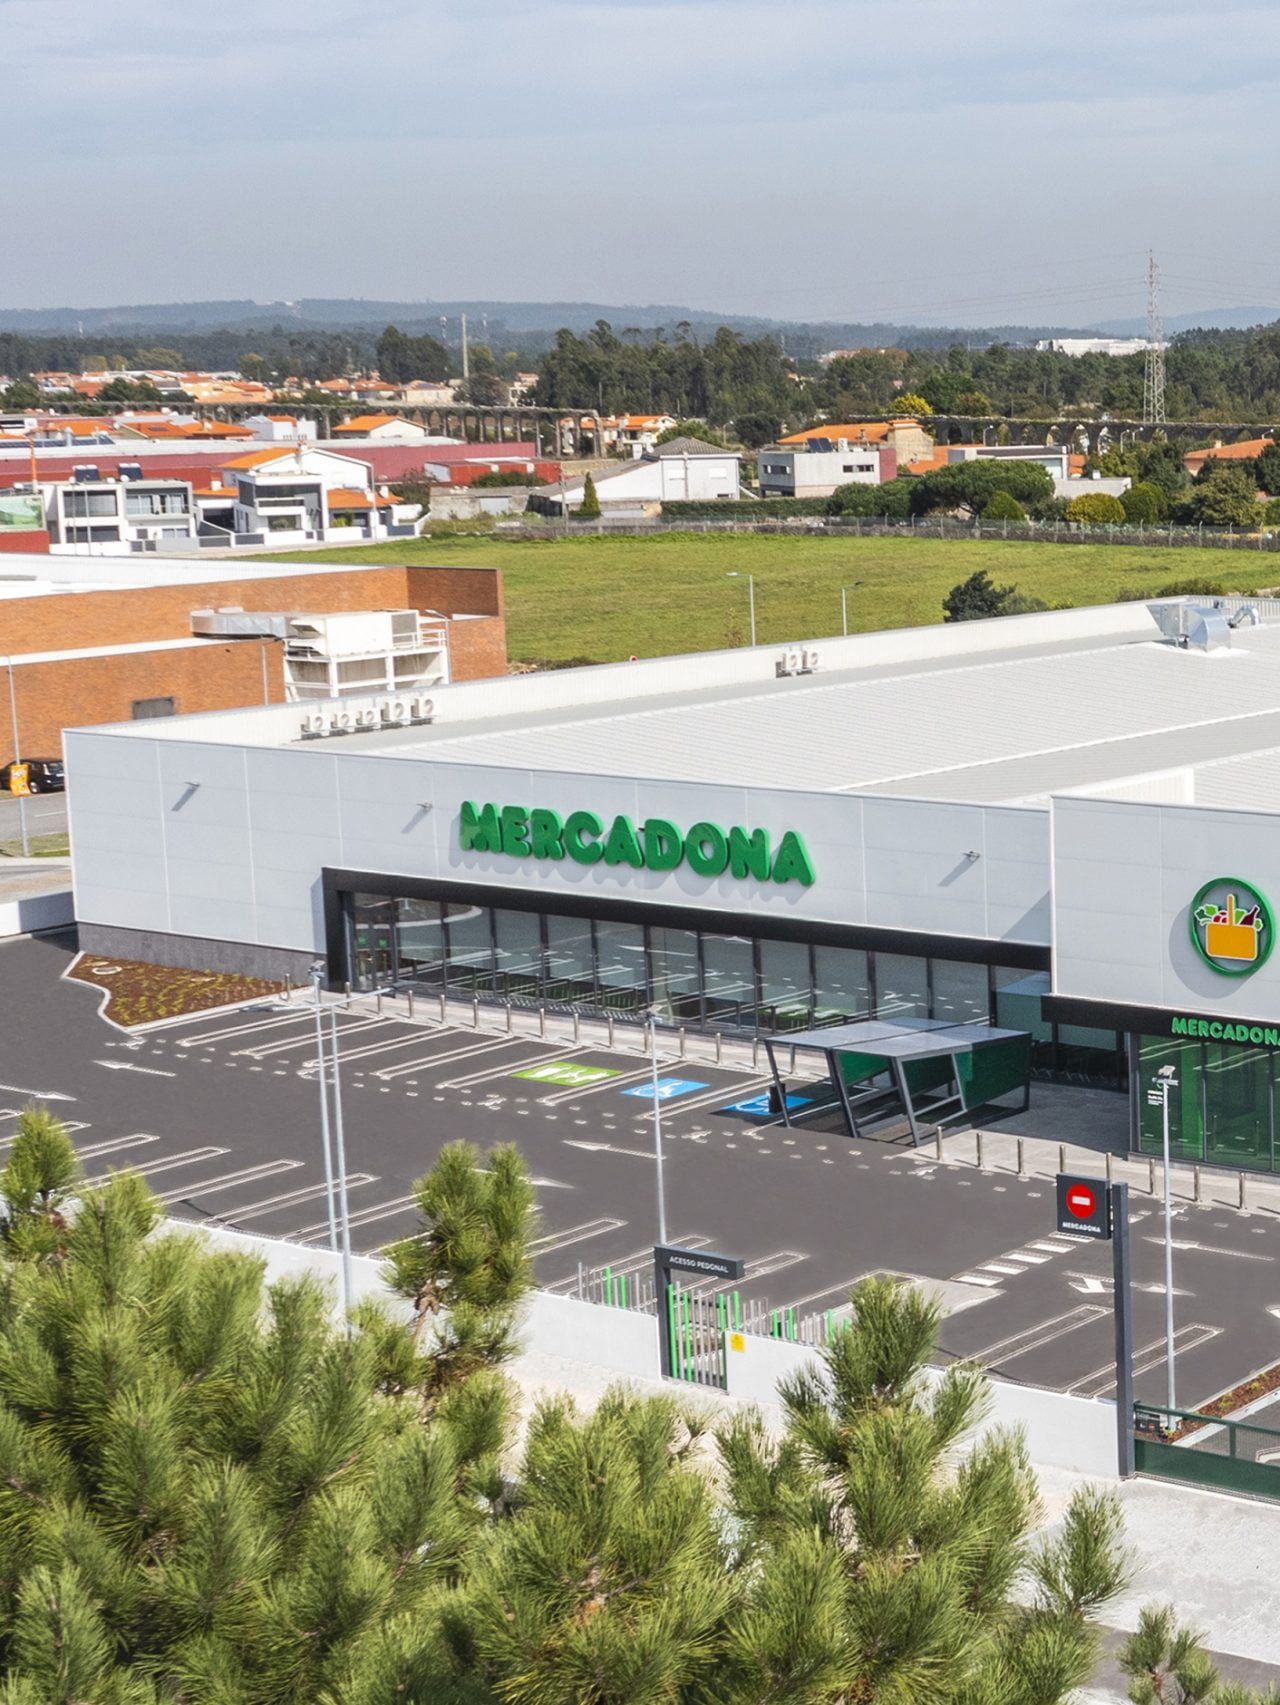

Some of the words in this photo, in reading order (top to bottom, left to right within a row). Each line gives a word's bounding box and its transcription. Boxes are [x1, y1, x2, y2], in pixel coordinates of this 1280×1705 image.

[459, 800, 815, 887] MERCADONA
[669, 1255, 696, 1267] ACESSO
[697, 1261, 729, 1273] PEDONAL
